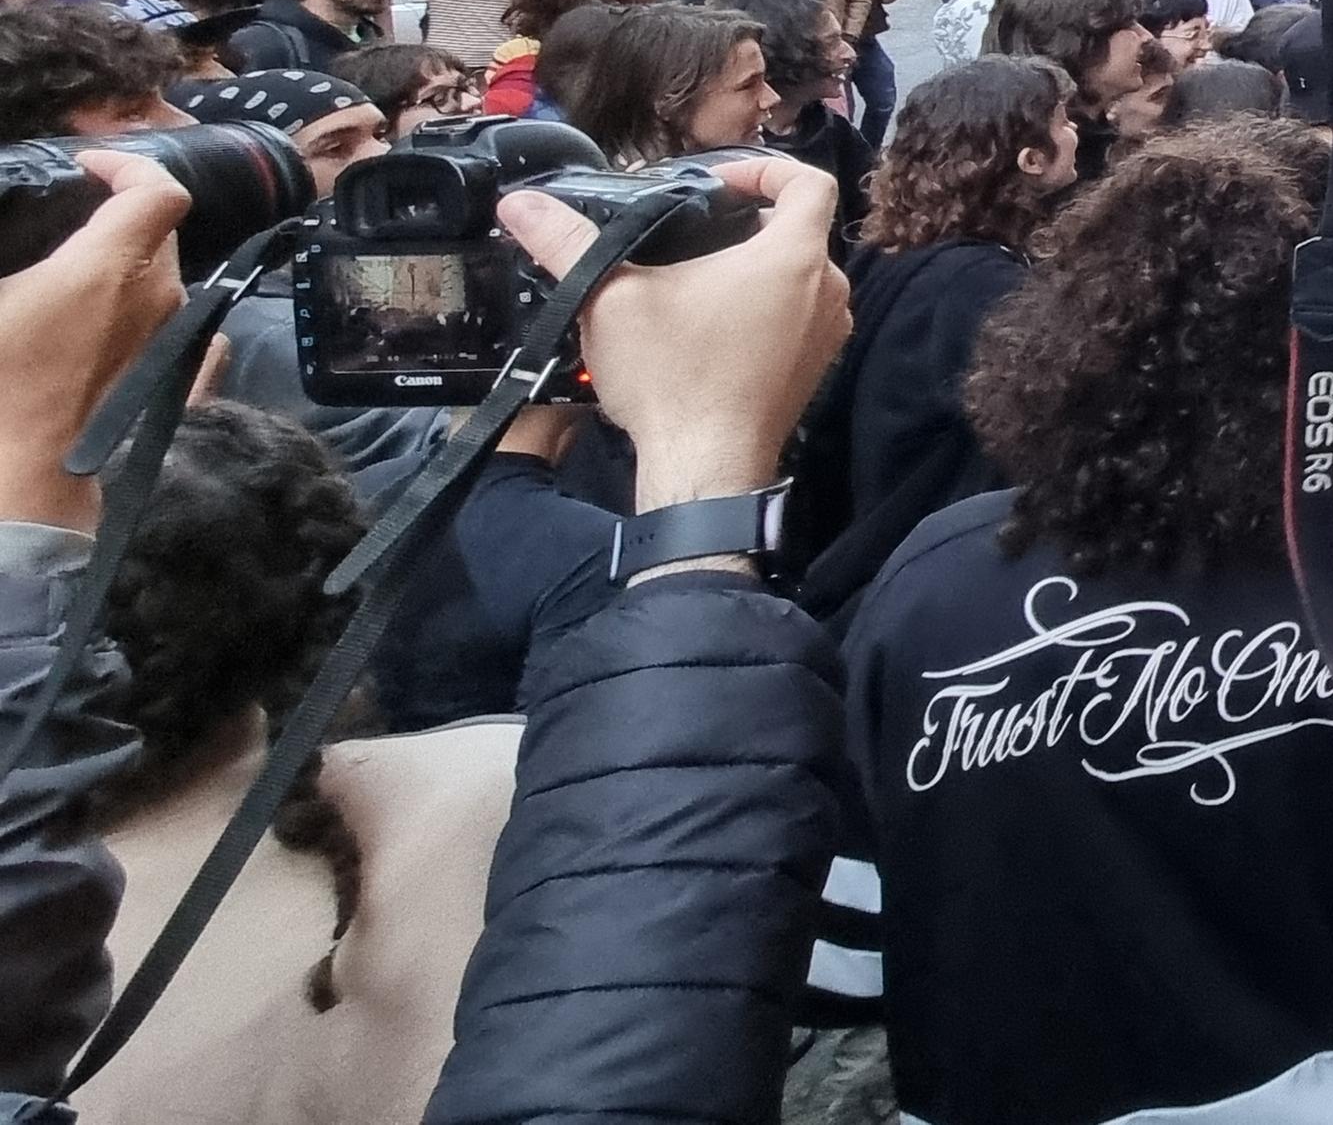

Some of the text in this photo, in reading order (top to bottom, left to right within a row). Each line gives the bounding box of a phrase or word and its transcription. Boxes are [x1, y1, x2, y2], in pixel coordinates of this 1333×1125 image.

[394, 375, 443, 386] Canon
[1302, 452, 1333, 493] R6
[906, 648, 1098, 792] Trust
[1079, 637, 1209, 747] No
